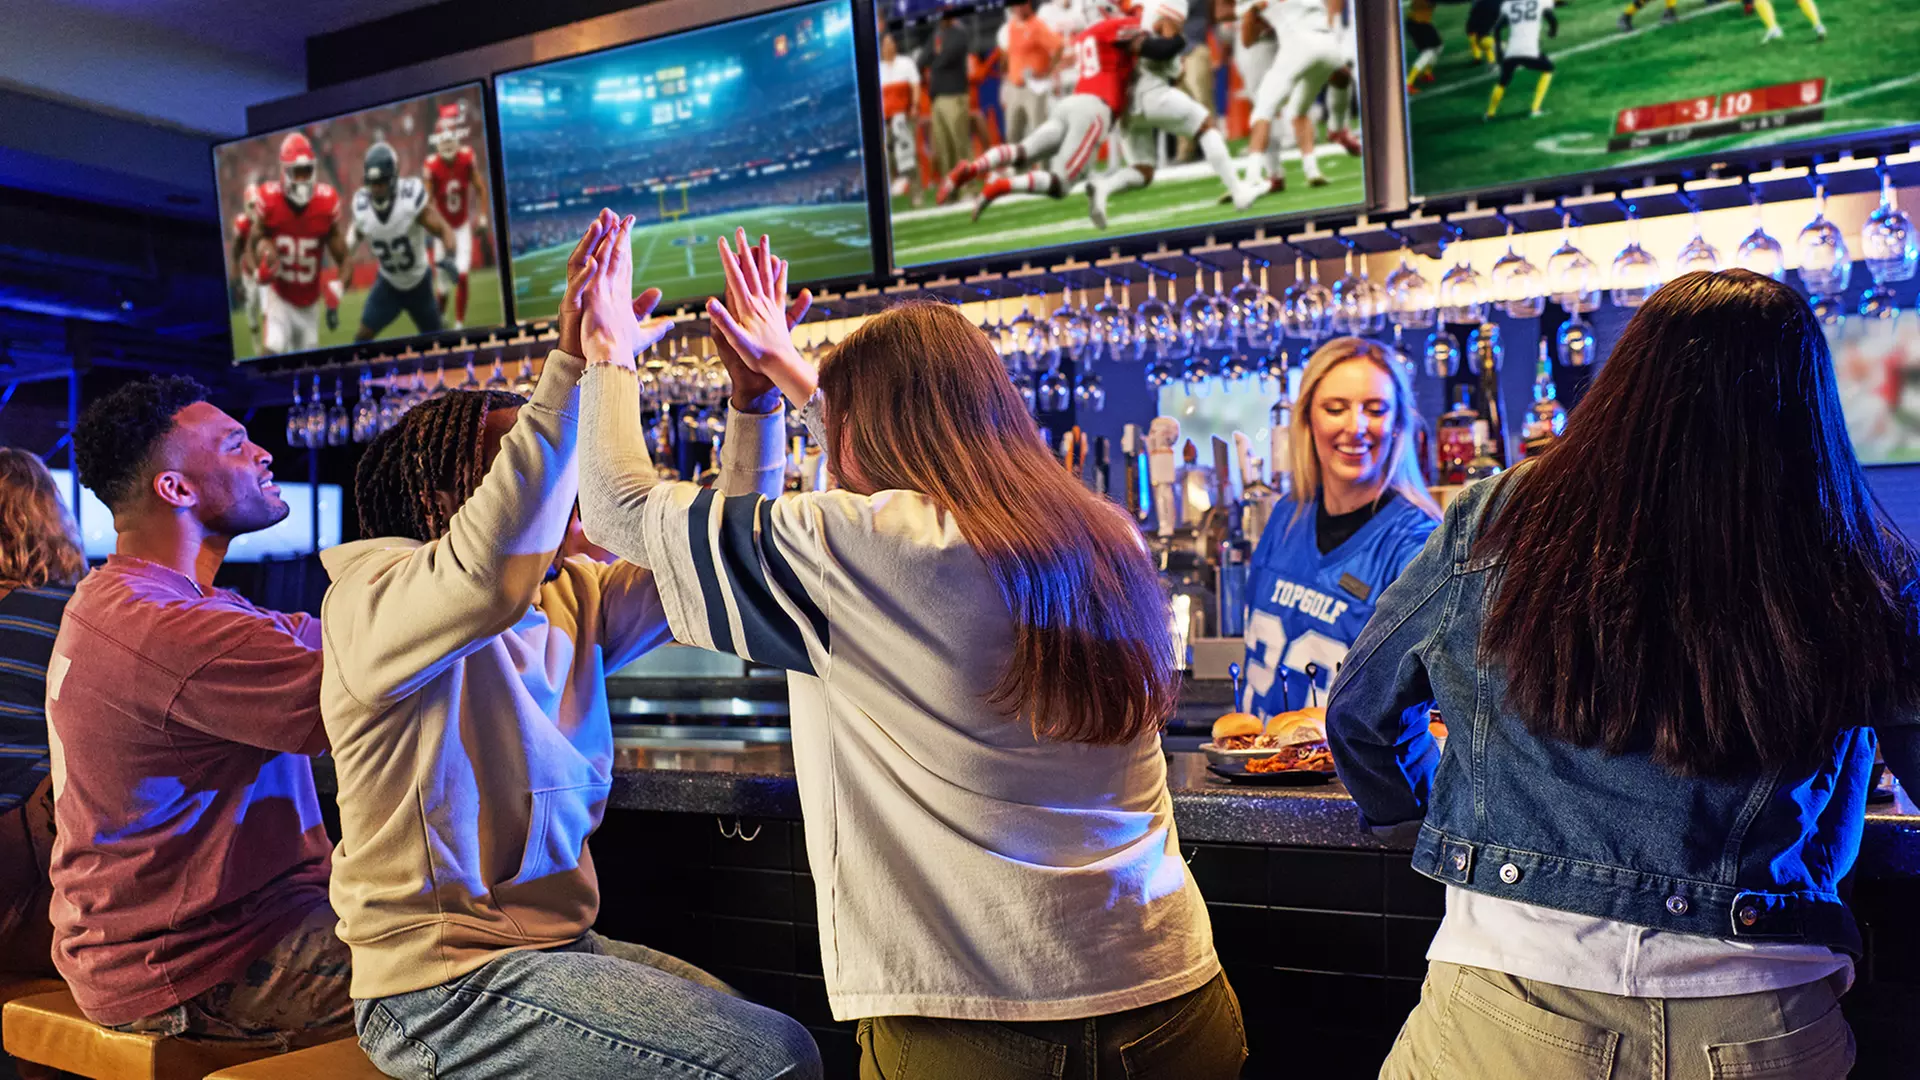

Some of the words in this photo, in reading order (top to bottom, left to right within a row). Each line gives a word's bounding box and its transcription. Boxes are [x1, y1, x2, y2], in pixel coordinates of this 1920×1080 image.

[1509, 0, 1538, 24] 52
[1694, 99, 1709, 119] 3
[1726, 92, 1753, 116] 10
[445, 179, 462, 213] 6
[276, 235, 318, 283] 25
[372, 235, 416, 274] 23
[1270, 578, 1349, 626] TOPGOLF
